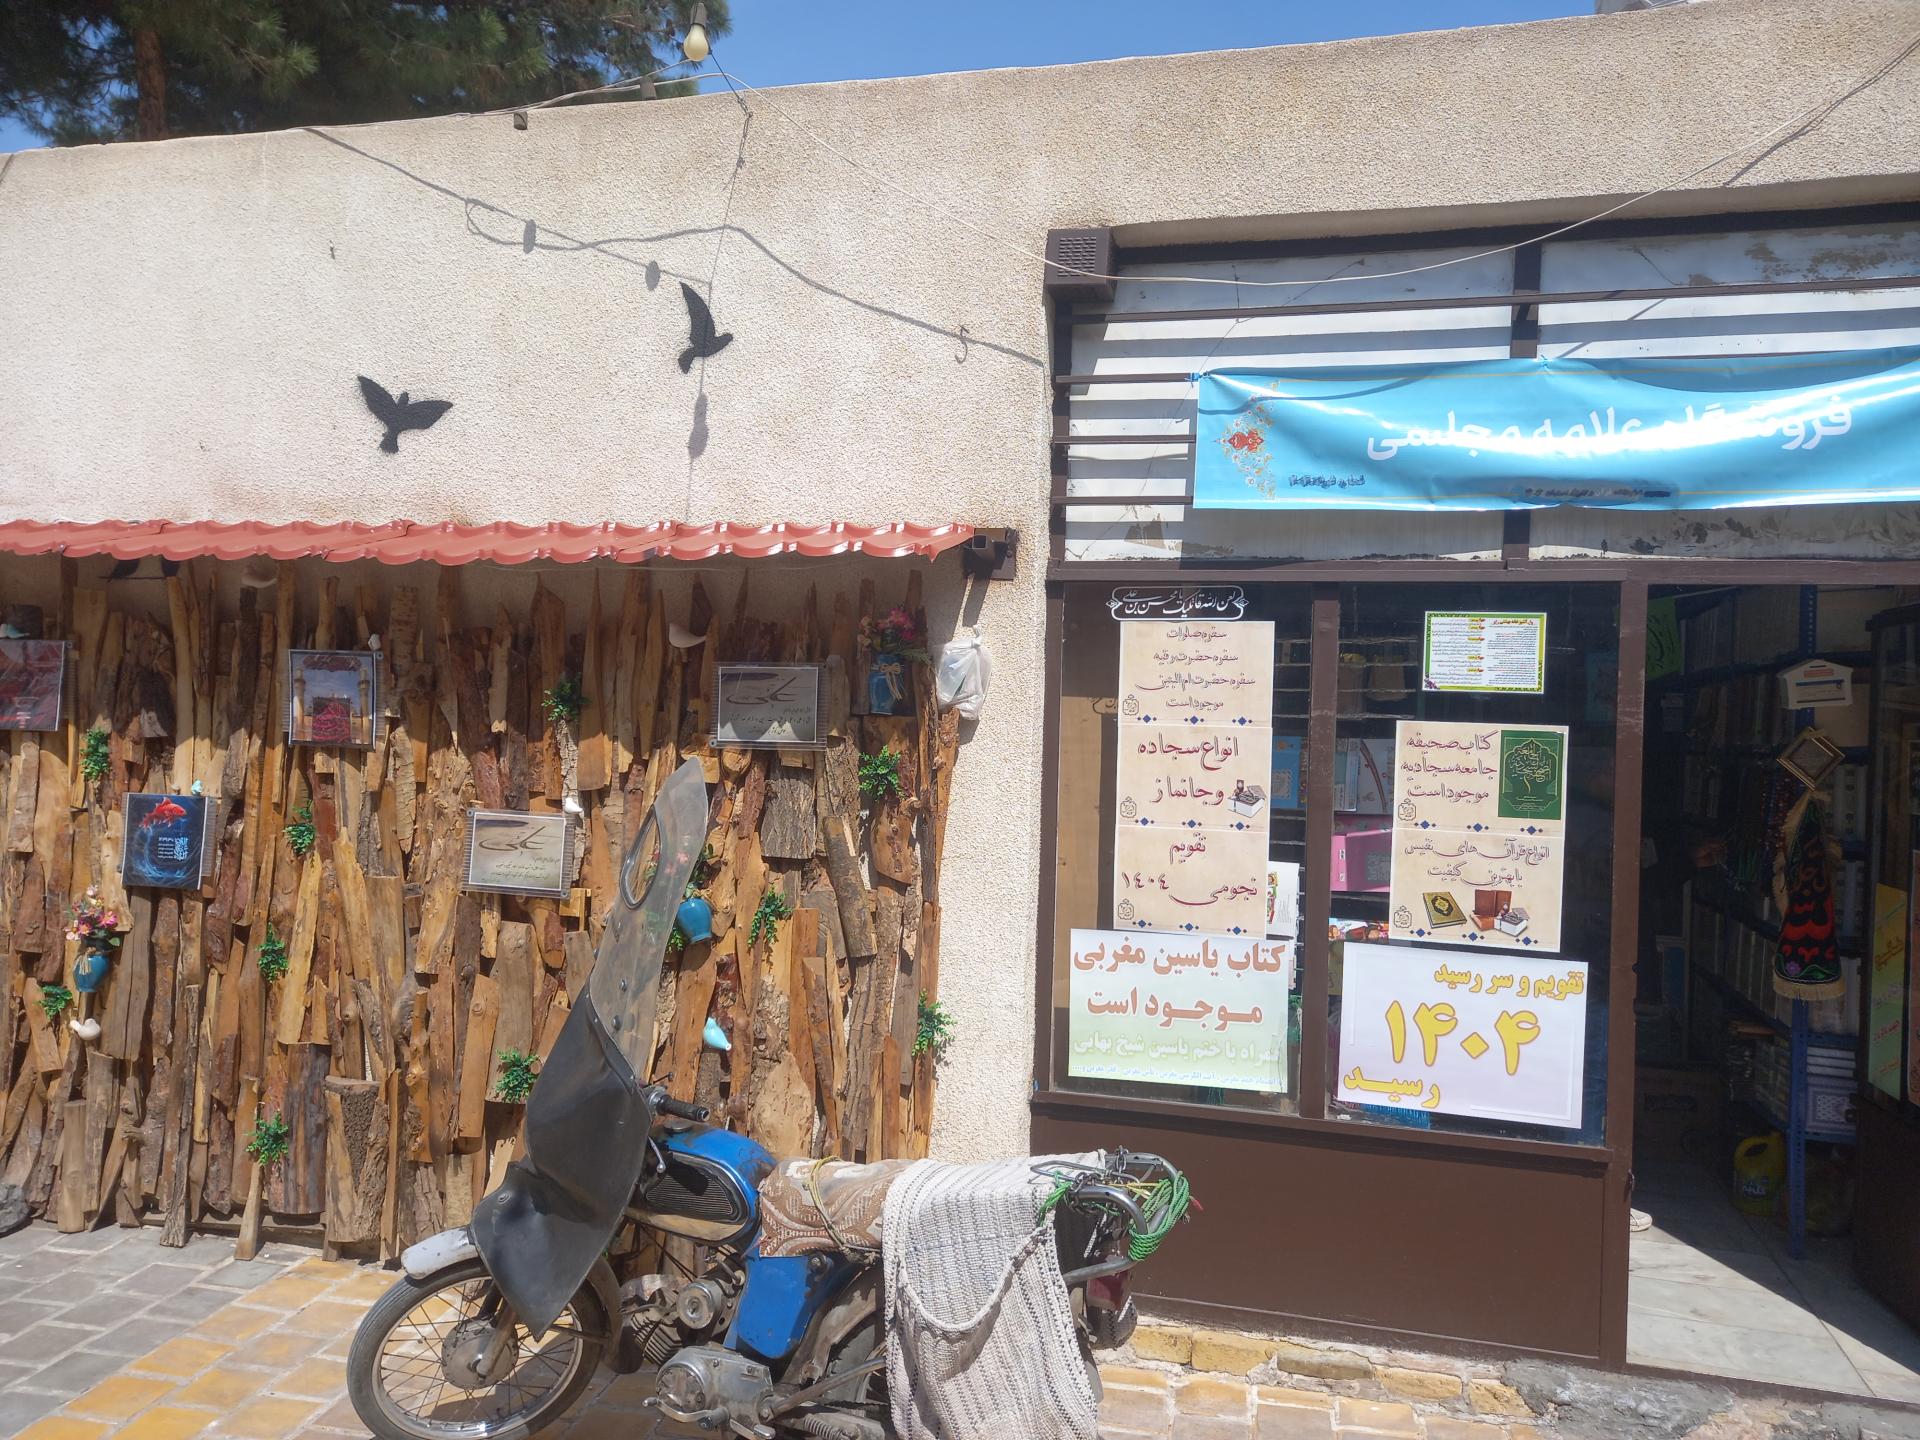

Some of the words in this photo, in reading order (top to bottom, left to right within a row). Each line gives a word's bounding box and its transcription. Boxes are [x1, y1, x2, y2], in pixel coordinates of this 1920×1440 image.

[1367, 410, 1522, 461] مجلسی
[1166, 626, 1201, 641] صلوات
[1201, 626, 1227, 642] سفره
[1153, 648, 1176, 665] رقیه
[1176, 649, 1212, 665] حضرت
[1212, 649, 1239, 666] سفره
[1192, 672, 1229, 689] حضرت
[1229, 672, 1256, 690] سفره
[1166, 696, 1194, 709] است
[1193, 696, 1224, 711] موجود
[1138, 732, 1200, 761] سجاده
[1200, 736, 1239, 771] انواع
[1407, 732, 1460, 754] صحیفه
[1459, 730, 1499, 755] کتاب
[1401, 757, 1455, 781] سجادیه
[1455, 758, 1497, 780] جامعه
[1150, 776, 1213, 805] جانماز
[1407, 782, 1447, 797] است
[1446, 788, 1489, 804] موجود
[1169, 832, 1207, 864] تقویم
[1405, 838, 1433, 856] نفیس
[1432, 841, 1478, 857] های
[1477, 838, 1526, 861] قرآن
[1526, 846, 1550, 866] انواع
[1428, 861, 1468, 882] کیفیت
[1514, 868, 1523, 888] با
[1169, 877, 1258, 906] نجومی
[1073, 935, 1146, 972] مغربی
[1153, 939, 1219, 977] یاسین
[1227, 942, 1286, 979] کتاب
[1434, 964, 1483, 993] رسید
[1486, 975, 1514, 994] سر
[1516, 975, 1530, 998] و
[1533, 972, 1585, 1000] تقویم
[1087, 986, 1138, 1016] است
[1145, 994, 1264, 1031] موجود
[1115, 1031, 1145, 1056] شیخ
[1148, 1036, 1188, 1061] یاسین
[1192, 1039, 1221, 1064] ختم
[1225, 1039, 1236, 1064] با
[1343, 1066, 1441, 1109] رسید
